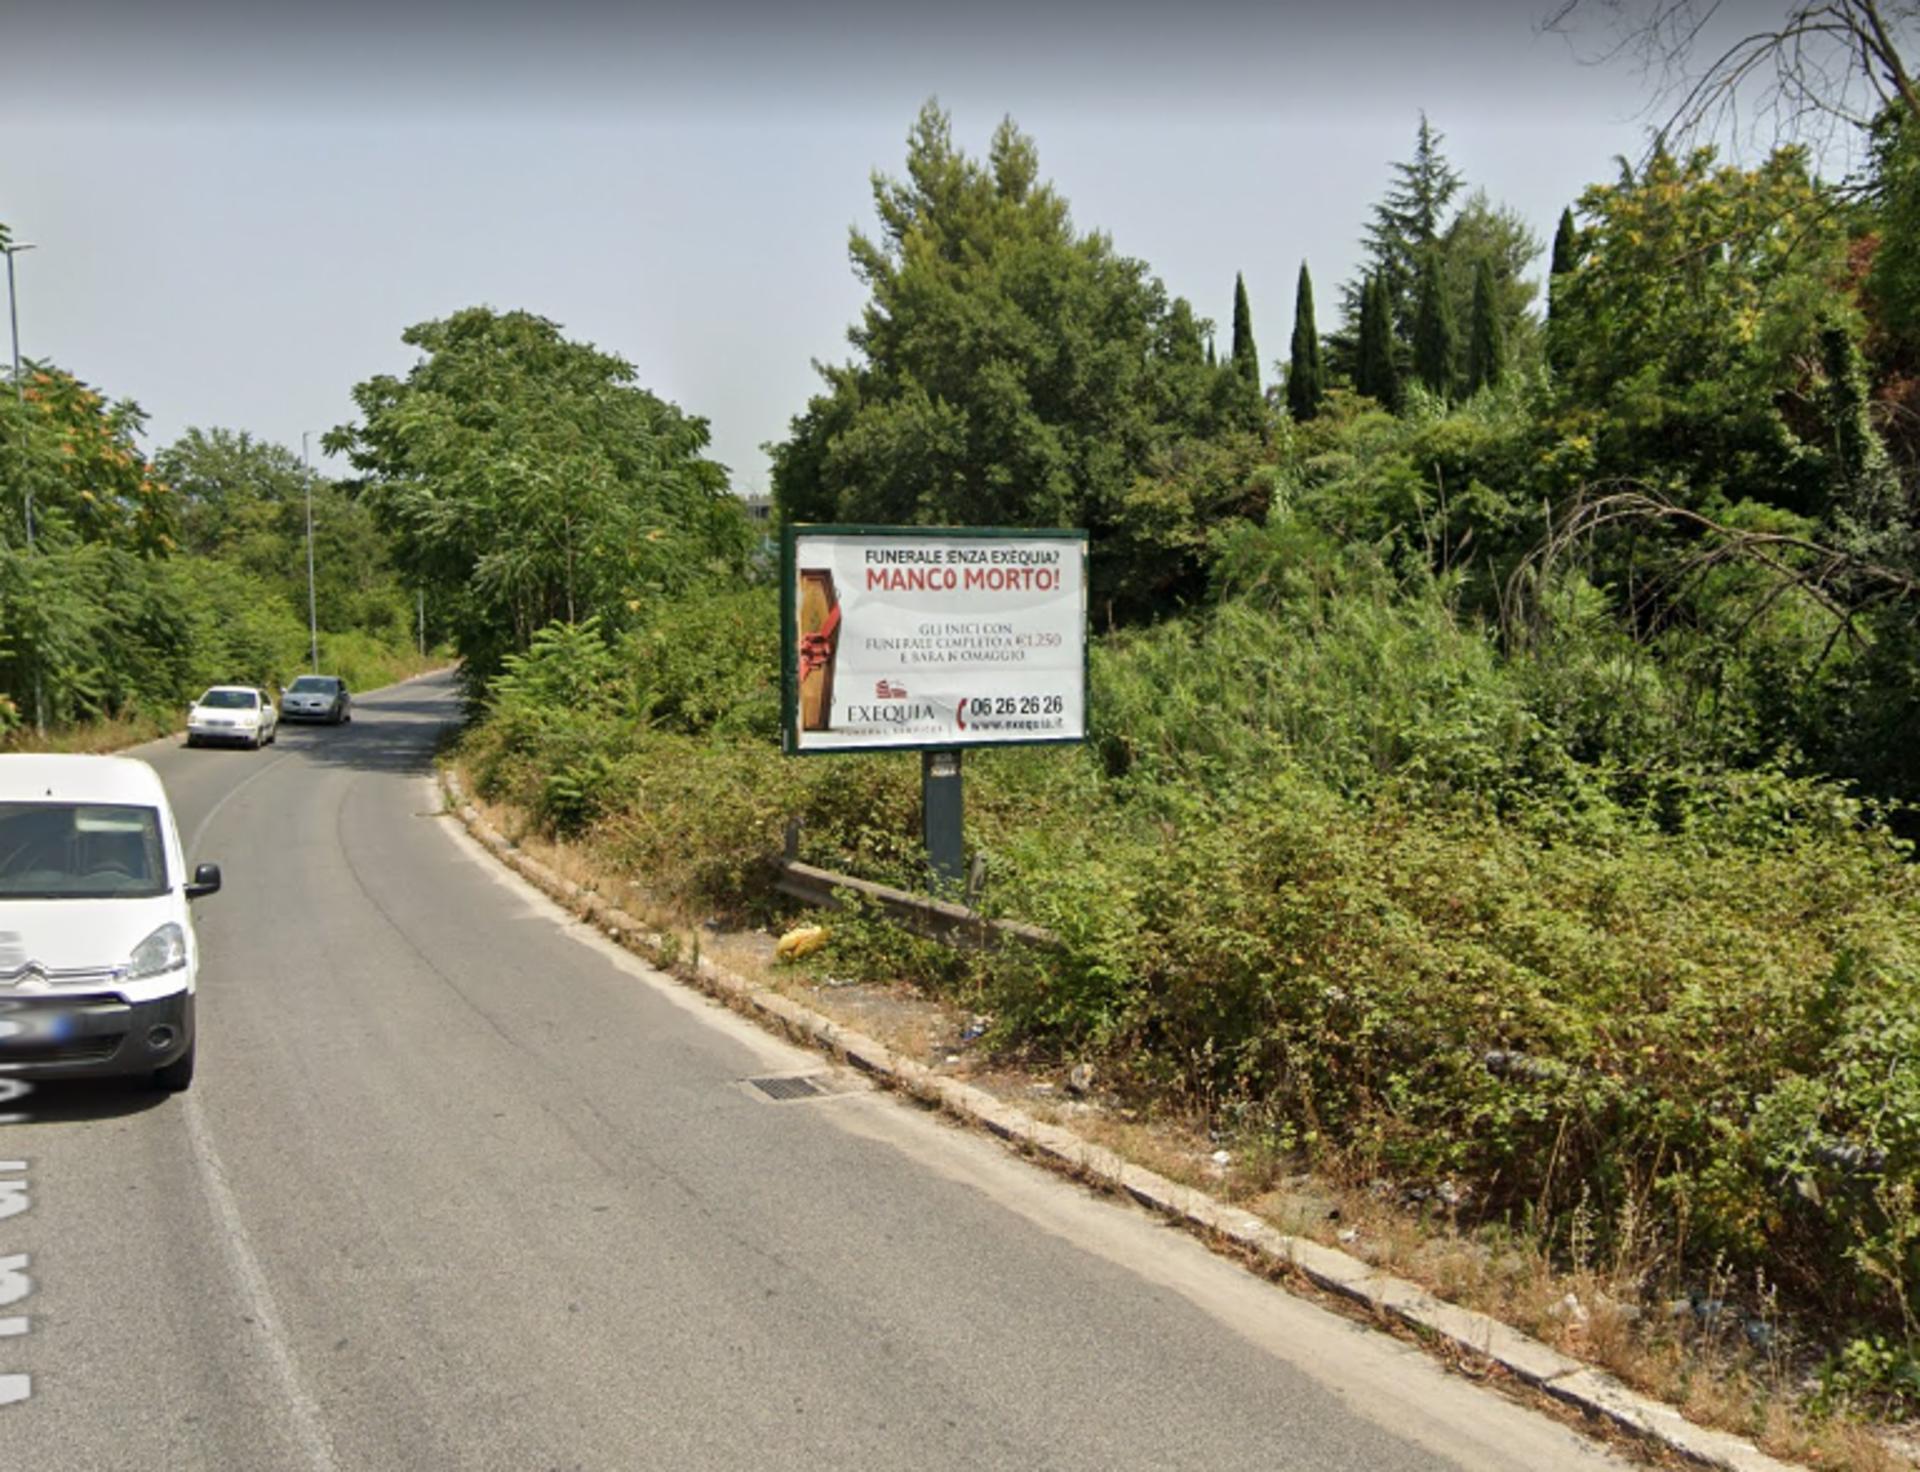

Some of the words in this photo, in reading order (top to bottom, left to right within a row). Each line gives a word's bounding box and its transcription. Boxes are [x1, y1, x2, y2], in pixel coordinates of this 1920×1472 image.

[866, 550, 941, 564] FUNERALE
[992, 550, 1060, 566] EXEQUIA?
[867, 568, 957, 591] MANCO
[964, 568, 1060, 591] MORTO!
[983, 623, 1013, 635] CON
[866, 638, 932, 650] FUNERALE
[848, 704, 935, 724] EXEQUIA
[971, 698, 991, 716] 06
[996, 698, 1016, 715] 26
[1020, 696, 1040, 714] 26
[1043, 695, 1063, 714] 26
